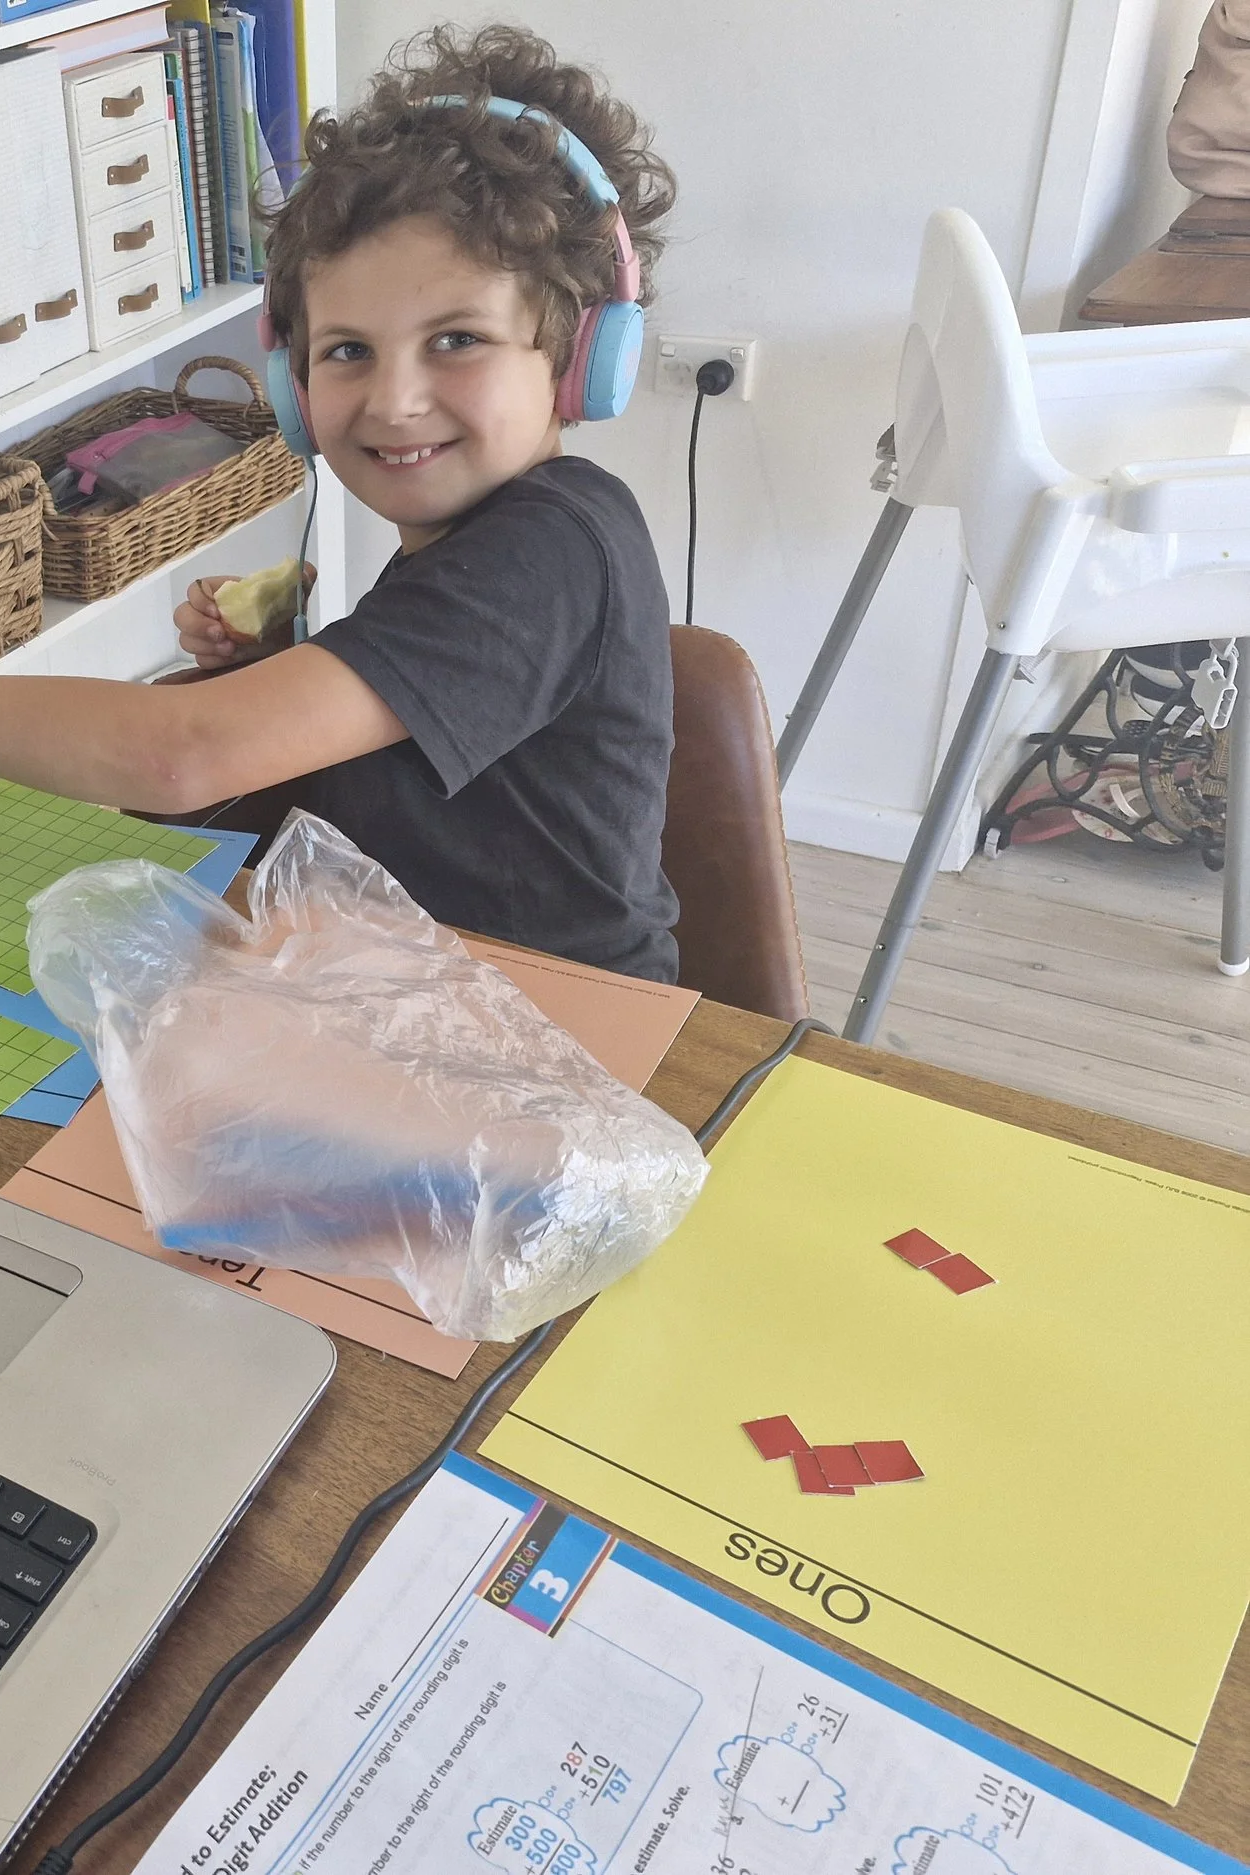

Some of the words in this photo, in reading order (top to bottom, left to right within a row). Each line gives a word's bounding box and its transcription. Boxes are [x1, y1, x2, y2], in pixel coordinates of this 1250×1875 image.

[68, 1456, 116, 1486] ProBook
[57, 1536, 72, 1546] ctrl
[24, 1574, 42, 1587] shift
[491, 1539, 541, 1604] Chapter
[529, 1569, 569, 1603] 3
[724, 1532, 871, 1624] Ones
[354, 1684, 388, 1720] Name
[798, 1694, 819, 1716] 26
[299, 1859, 310, 1869] if
[306, 1843, 325, 1861] the
[322, 1798, 354, 1842] number
[350, 1786, 364, 1799] to
[359, 1768, 377, 1785] the
[374, 1742, 395, 1767] right
[392, 1729, 403, 1742] of
[398, 1713, 415, 1730] the
[413, 1671, 448, 1713] rounding
[443, 1648, 462, 1670] digit
[459, 1638, 469, 1650] is
[387, 1836, 401, 1848] to
[397, 1816, 415, 1835] the
[411, 1789, 433, 1815] right
[429, 1775, 441, 1789] of
[436, 1759, 453, 1776] the
[450, 1715, 486, 1759] rounding
[480, 1691, 499, 1714] digit
[496, 1681, 507, 1693] is
[561, 1742, 587, 1777] 287
[725, 1743, 760, 1792] Estimate
[602, 1767, 632, 1805] 797
[976, 1774, 1002, 1805] 101
[192, 1846, 211, 1866] to
[207, 1765, 276, 1844] Estimate;
[248, 1771, 307, 1844] Addition
[476, 1804, 518, 1856] Estimate
[505, 1815, 536, 1851] 300
[634, 1823, 669, 1873] estimate.
[662, 1786, 691, 1819] Solve.
